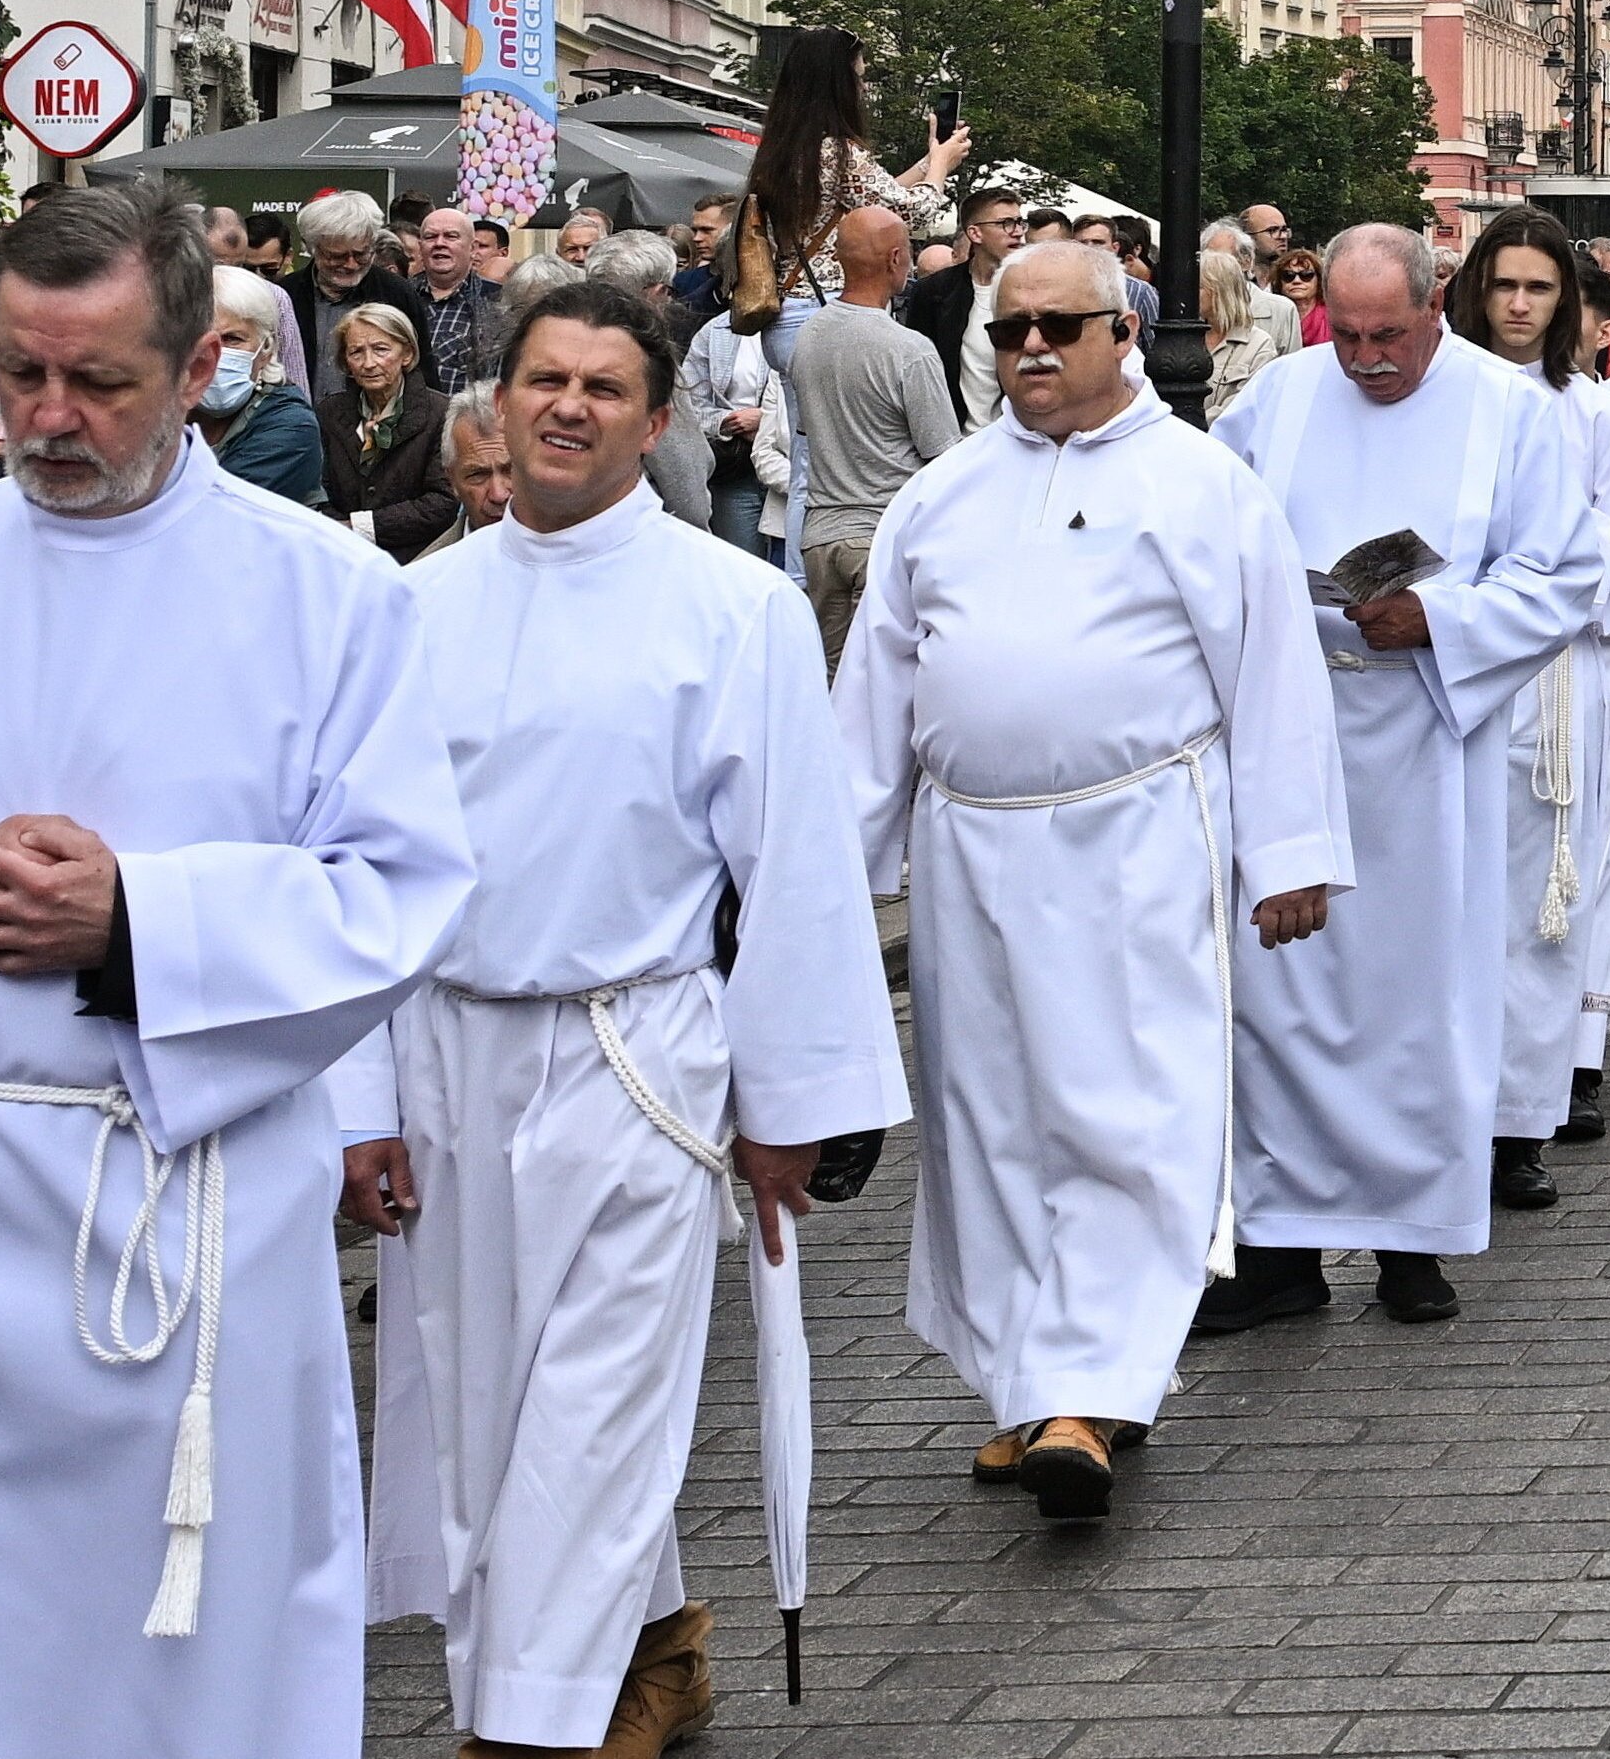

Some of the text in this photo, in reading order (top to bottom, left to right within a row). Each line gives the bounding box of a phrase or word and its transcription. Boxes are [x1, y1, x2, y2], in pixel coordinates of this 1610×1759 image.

[522, 31, 541, 76] ICE
[35, 79, 99, 116] NEM
[252, 202, 302, 213] MADE BY
